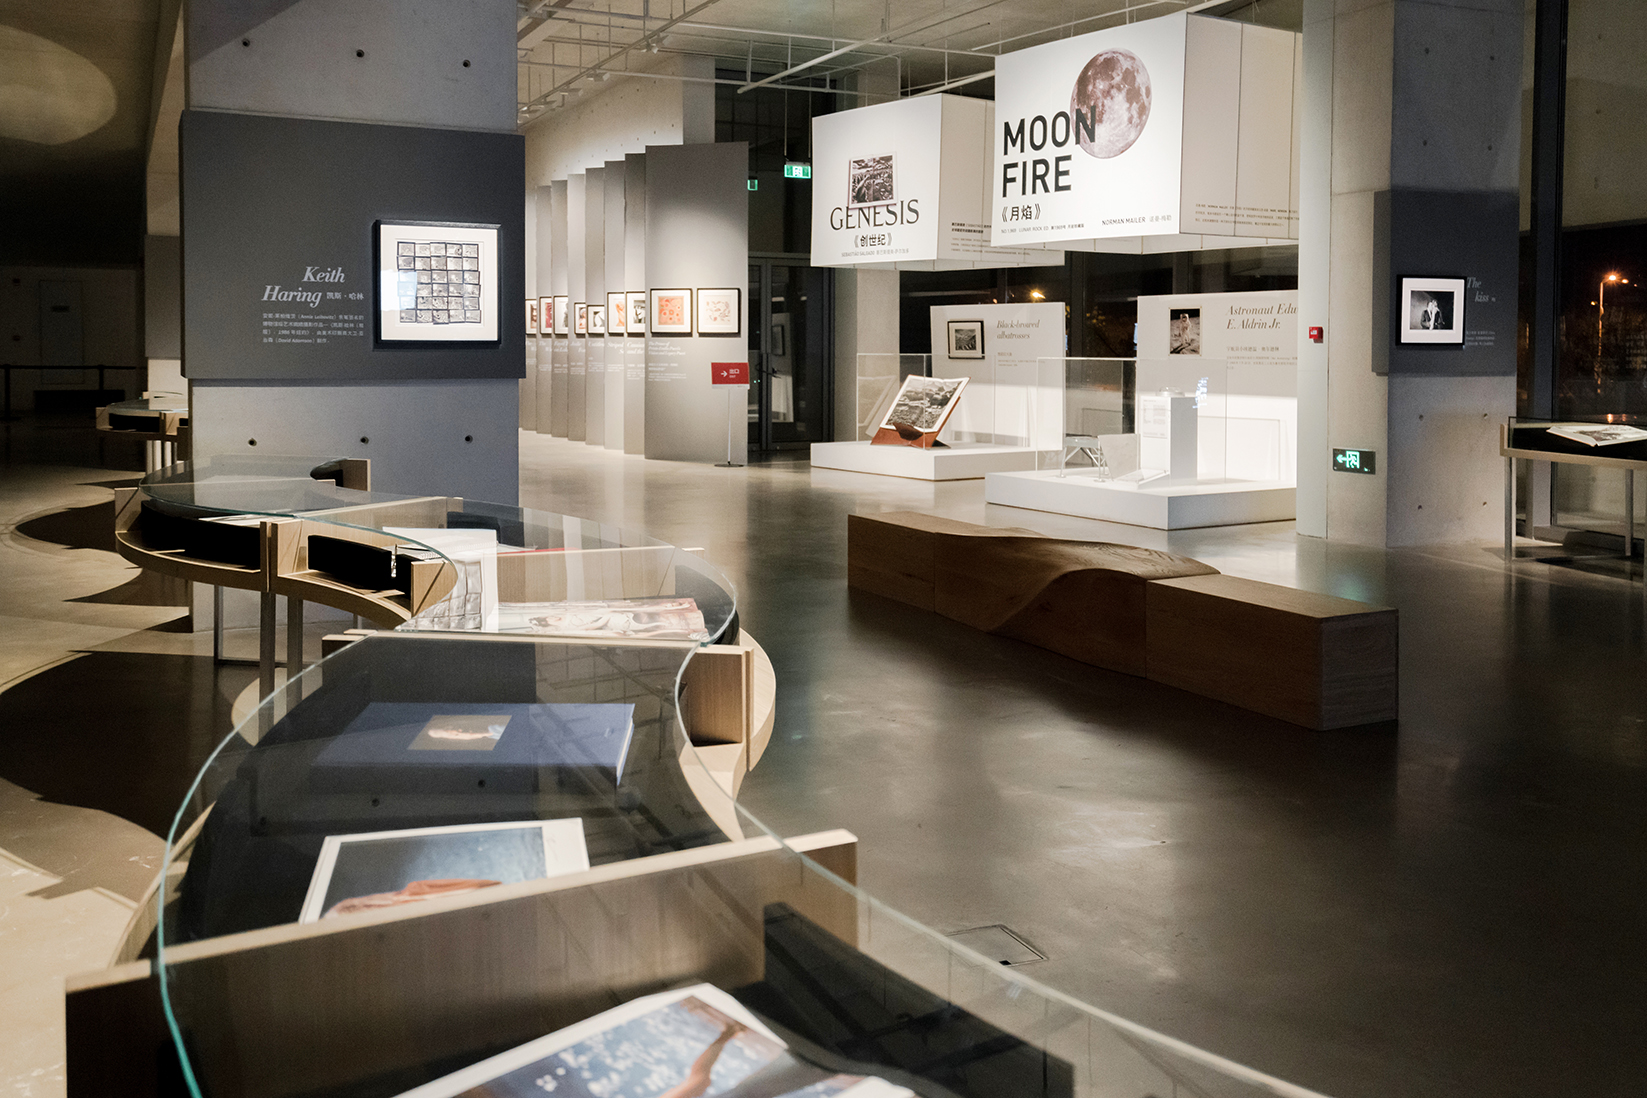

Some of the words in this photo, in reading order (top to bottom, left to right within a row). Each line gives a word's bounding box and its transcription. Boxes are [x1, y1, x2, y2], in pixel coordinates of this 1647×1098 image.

[1003, 105, 1096, 156] MOON
[1002, 154, 1072, 198] FIRE
[830, 199, 920, 231] GENESIS
[302, 266, 346, 283] Keith
[261, 285, 322, 308] Haring
[1225, 305, 1274, 316] Astronaut
[1238, 318, 1267, 330] Aldrin
